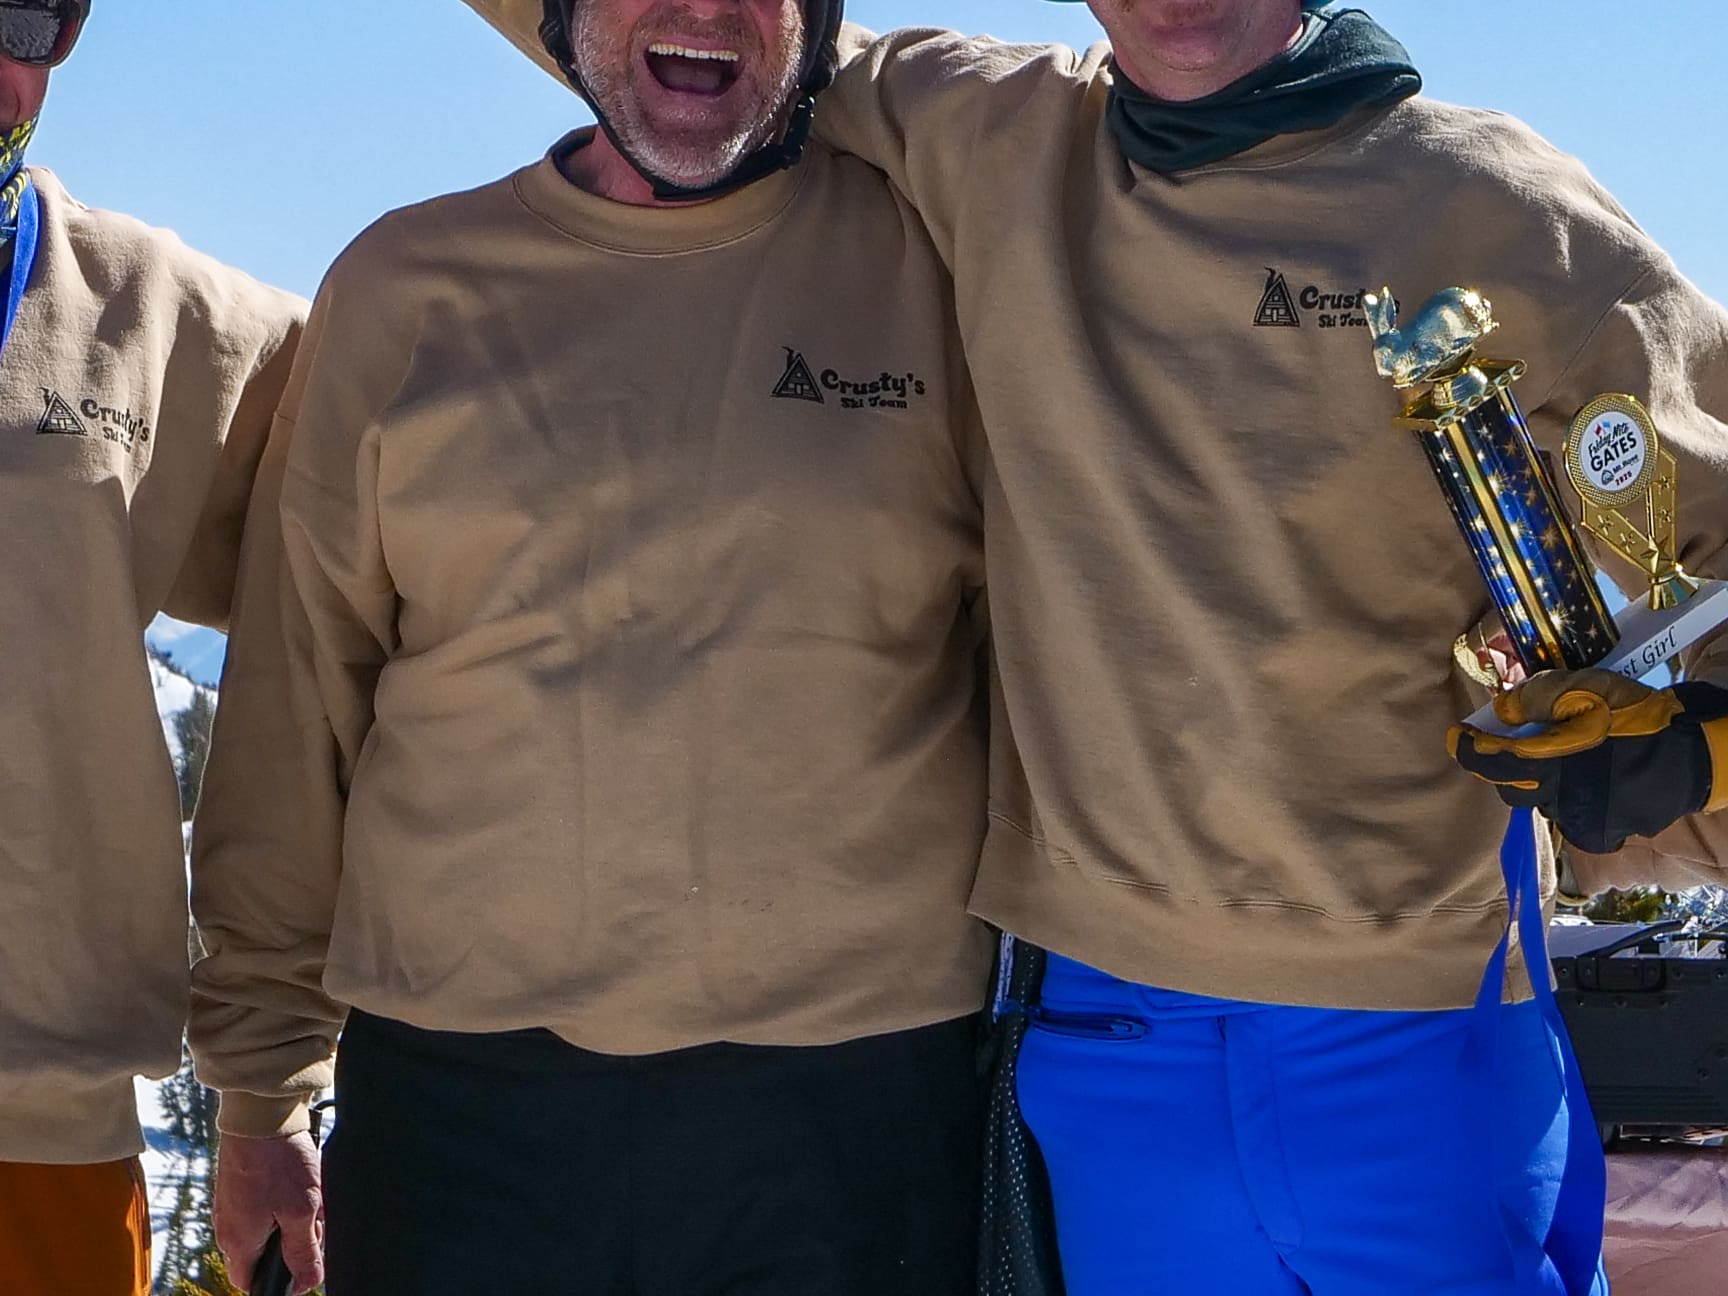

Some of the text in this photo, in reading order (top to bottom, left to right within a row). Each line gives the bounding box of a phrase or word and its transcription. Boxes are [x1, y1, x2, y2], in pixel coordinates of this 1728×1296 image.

[1318, 313, 1336, 328] Ski
[820, 369, 925, 398] Crusty's
[841, 395, 908, 408] Ski Team
[1591, 432, 1636, 471] GATES
[1642, 626, 1678, 668] Girl
